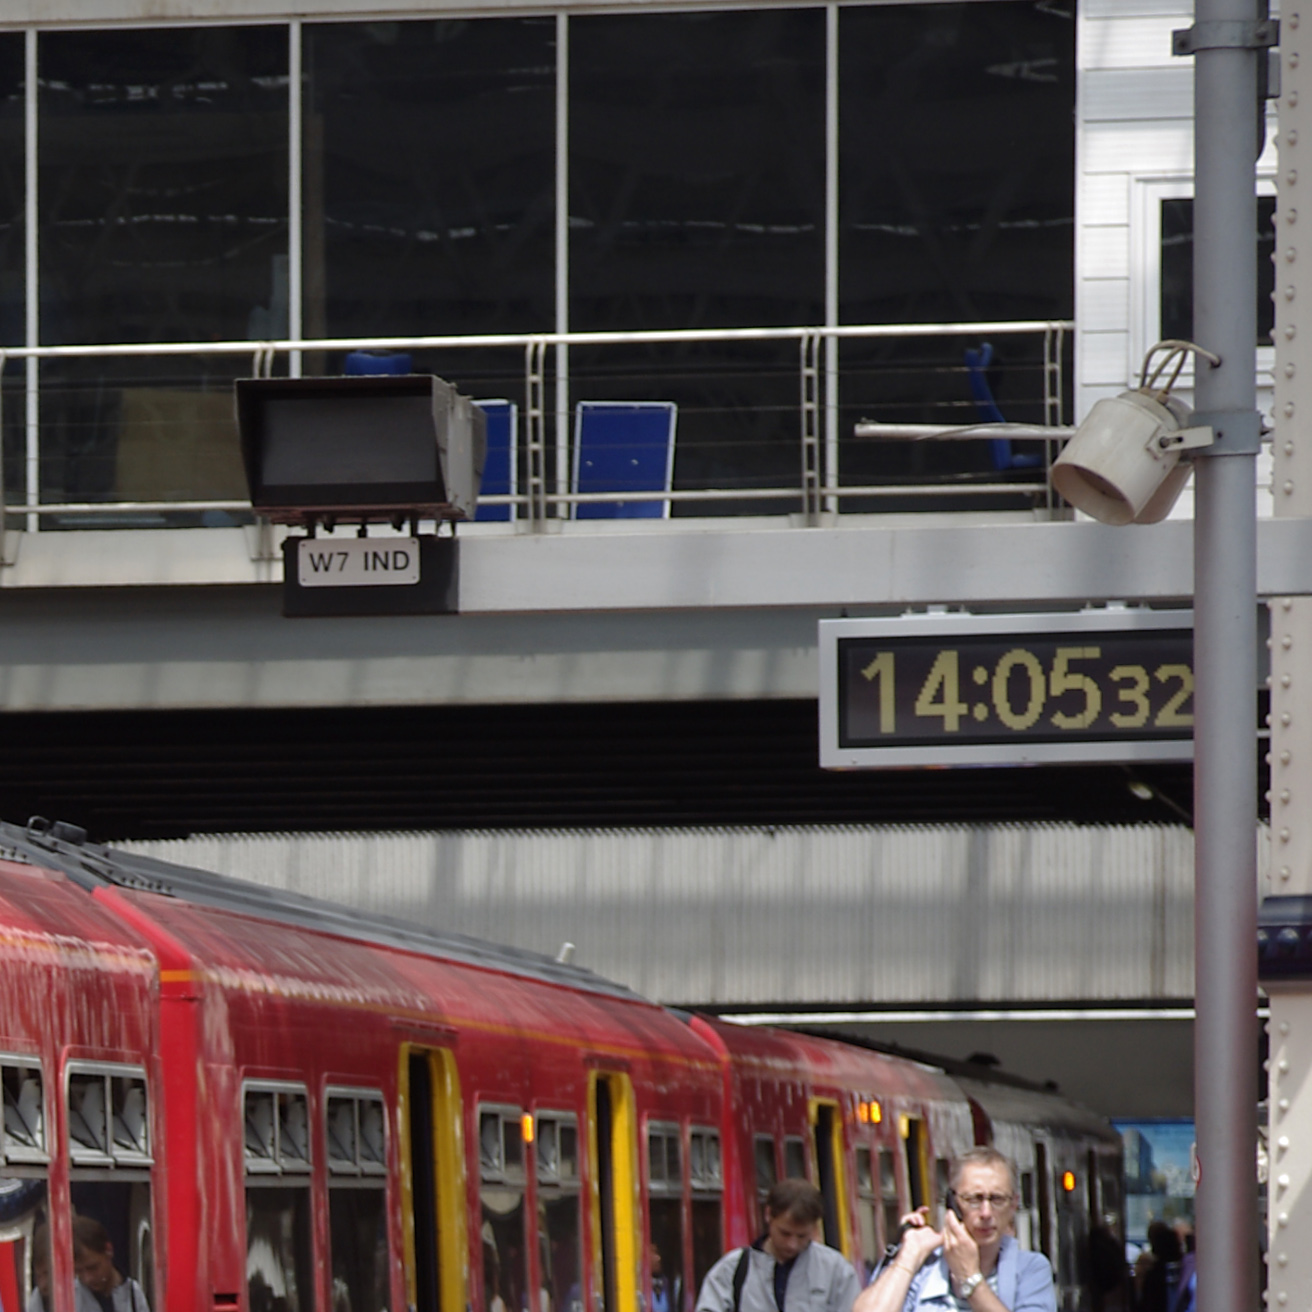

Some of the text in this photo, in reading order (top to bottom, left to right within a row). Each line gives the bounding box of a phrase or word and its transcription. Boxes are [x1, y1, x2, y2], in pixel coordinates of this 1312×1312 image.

[308, 550, 410, 573] W7 IND
[860, 645, 1195, 734] 14:05 32
